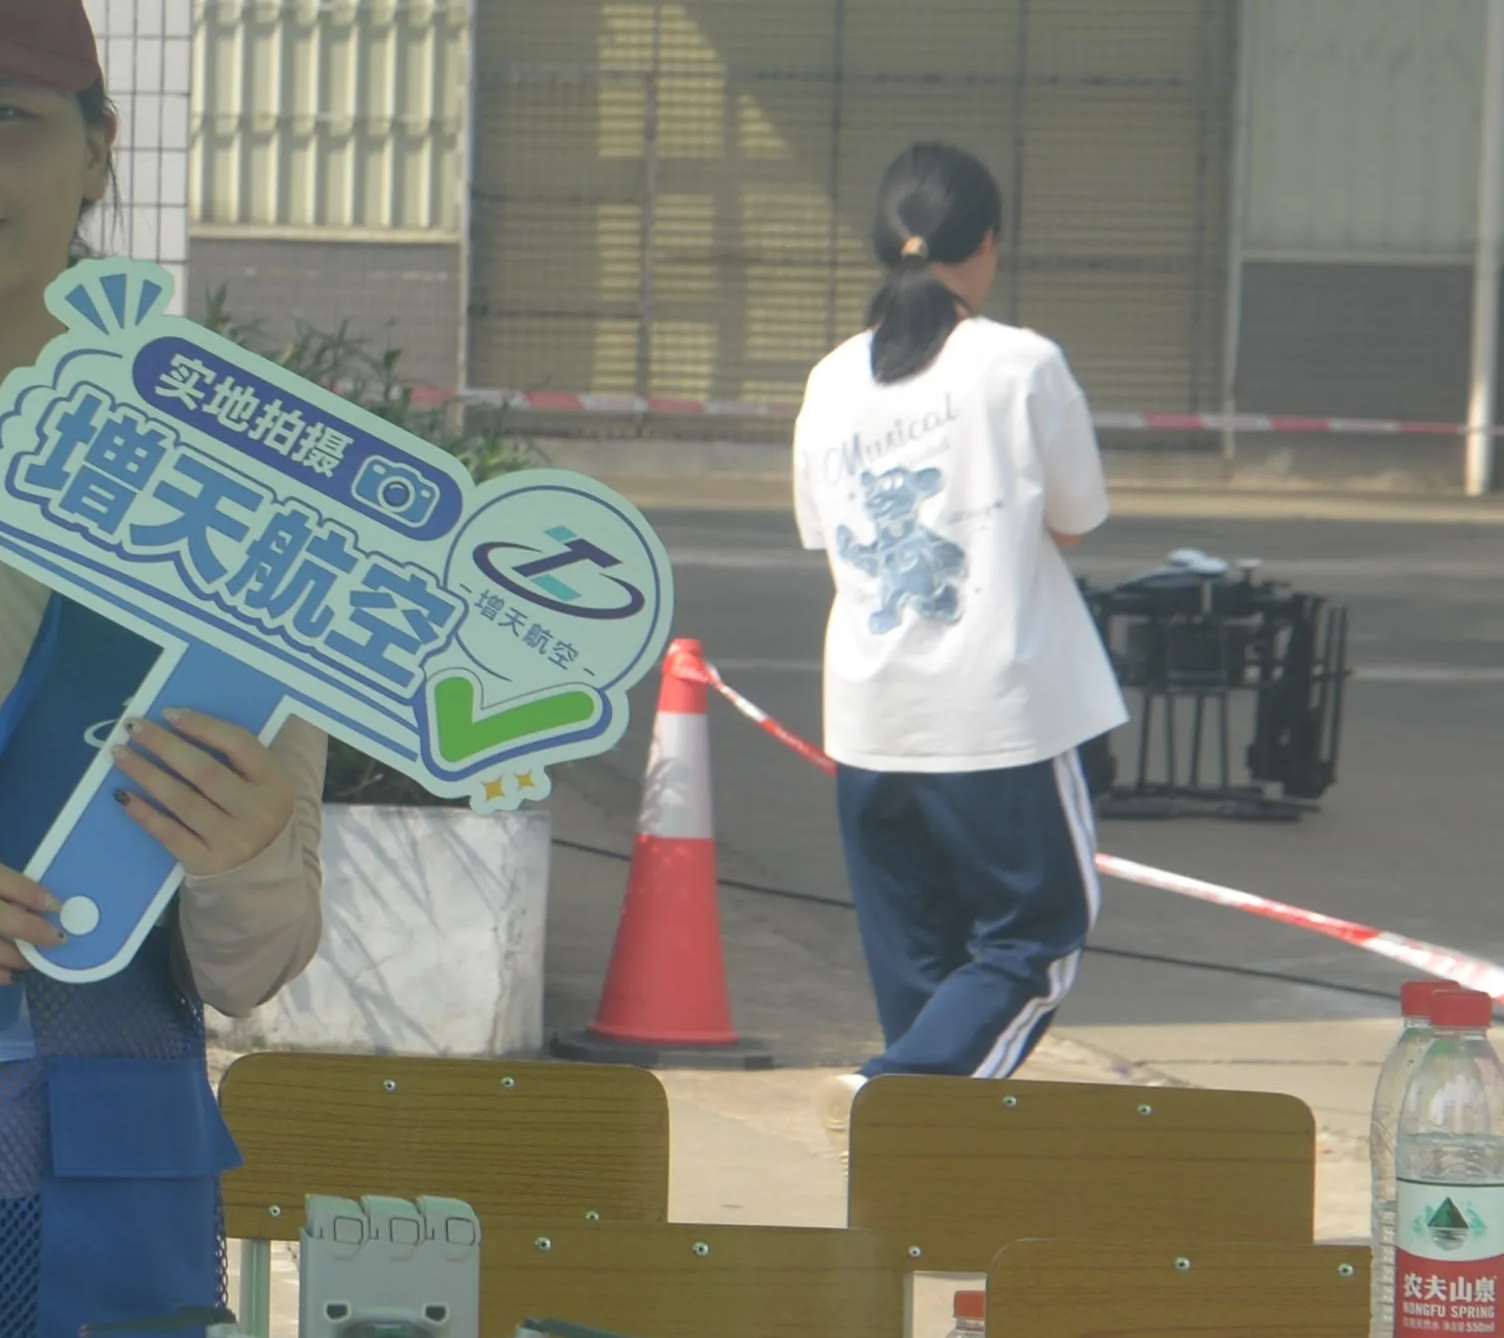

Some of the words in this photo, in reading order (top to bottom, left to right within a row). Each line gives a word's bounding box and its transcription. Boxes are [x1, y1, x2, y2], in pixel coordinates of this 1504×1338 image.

[154, 352, 355, 478] 实地拍摄
[23, 392, 456, 691] 增天航空
[474, 589, 580, 671] 增天航空
[1403, 1272, 1495, 1303] 农夫山泉
[1450, 1305, 1495, 1319] SPRING
